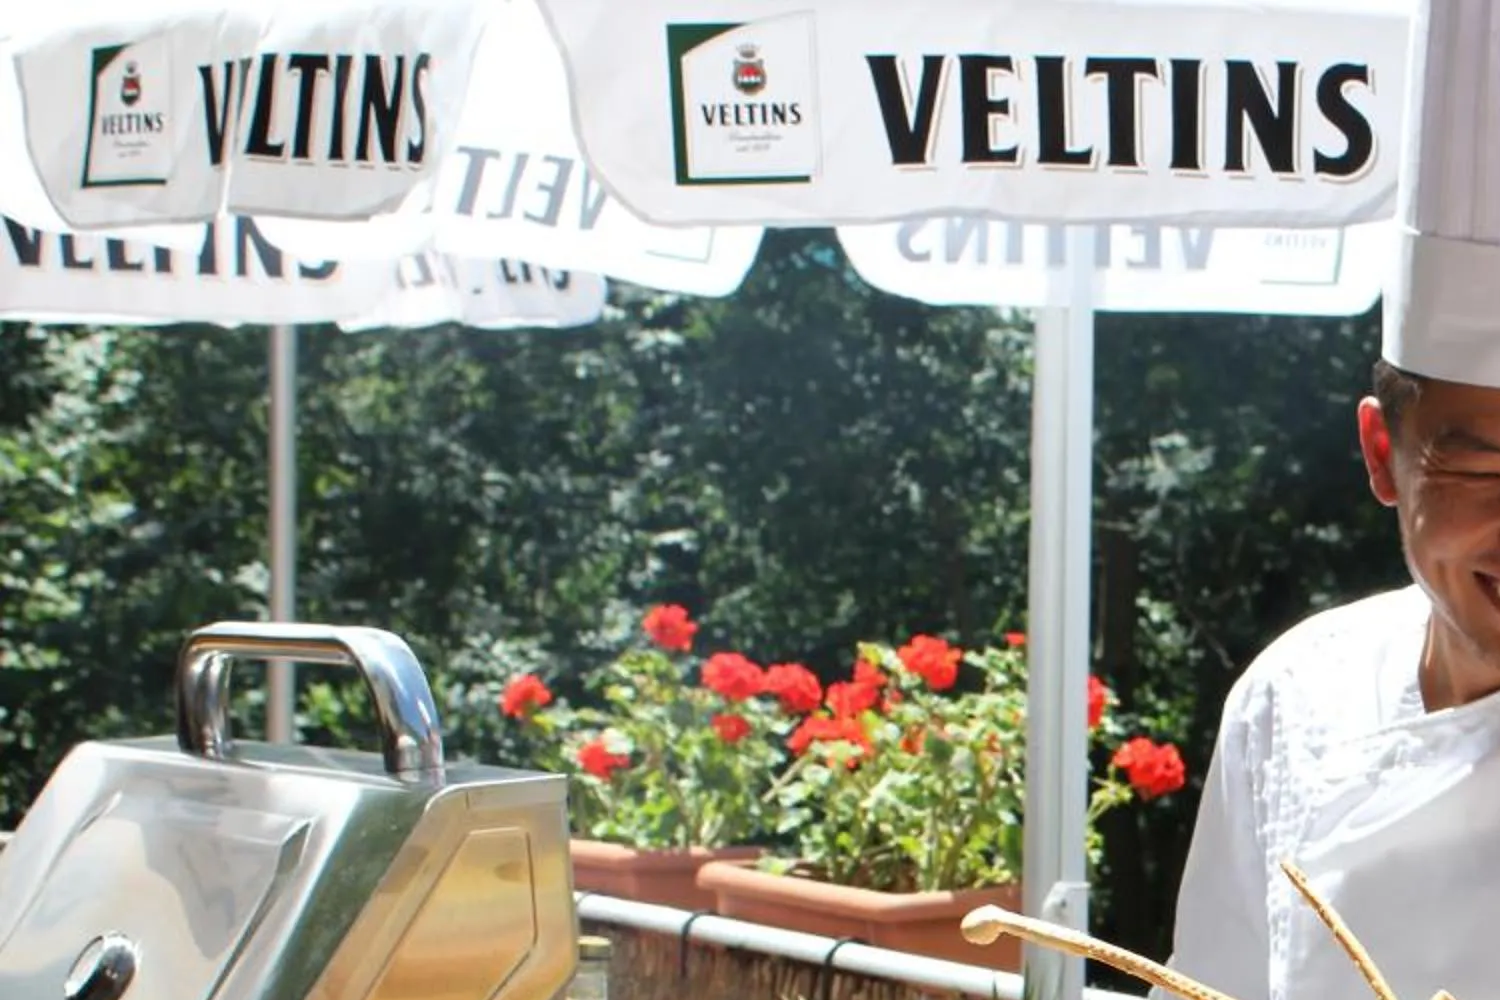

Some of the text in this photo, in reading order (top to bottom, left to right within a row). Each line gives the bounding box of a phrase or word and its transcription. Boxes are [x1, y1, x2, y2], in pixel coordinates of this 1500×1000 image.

[197, 52, 432, 168] VLTINS
[701, 102, 802, 126] VELTINS
[866, 55, 1376, 181] VELTINS
